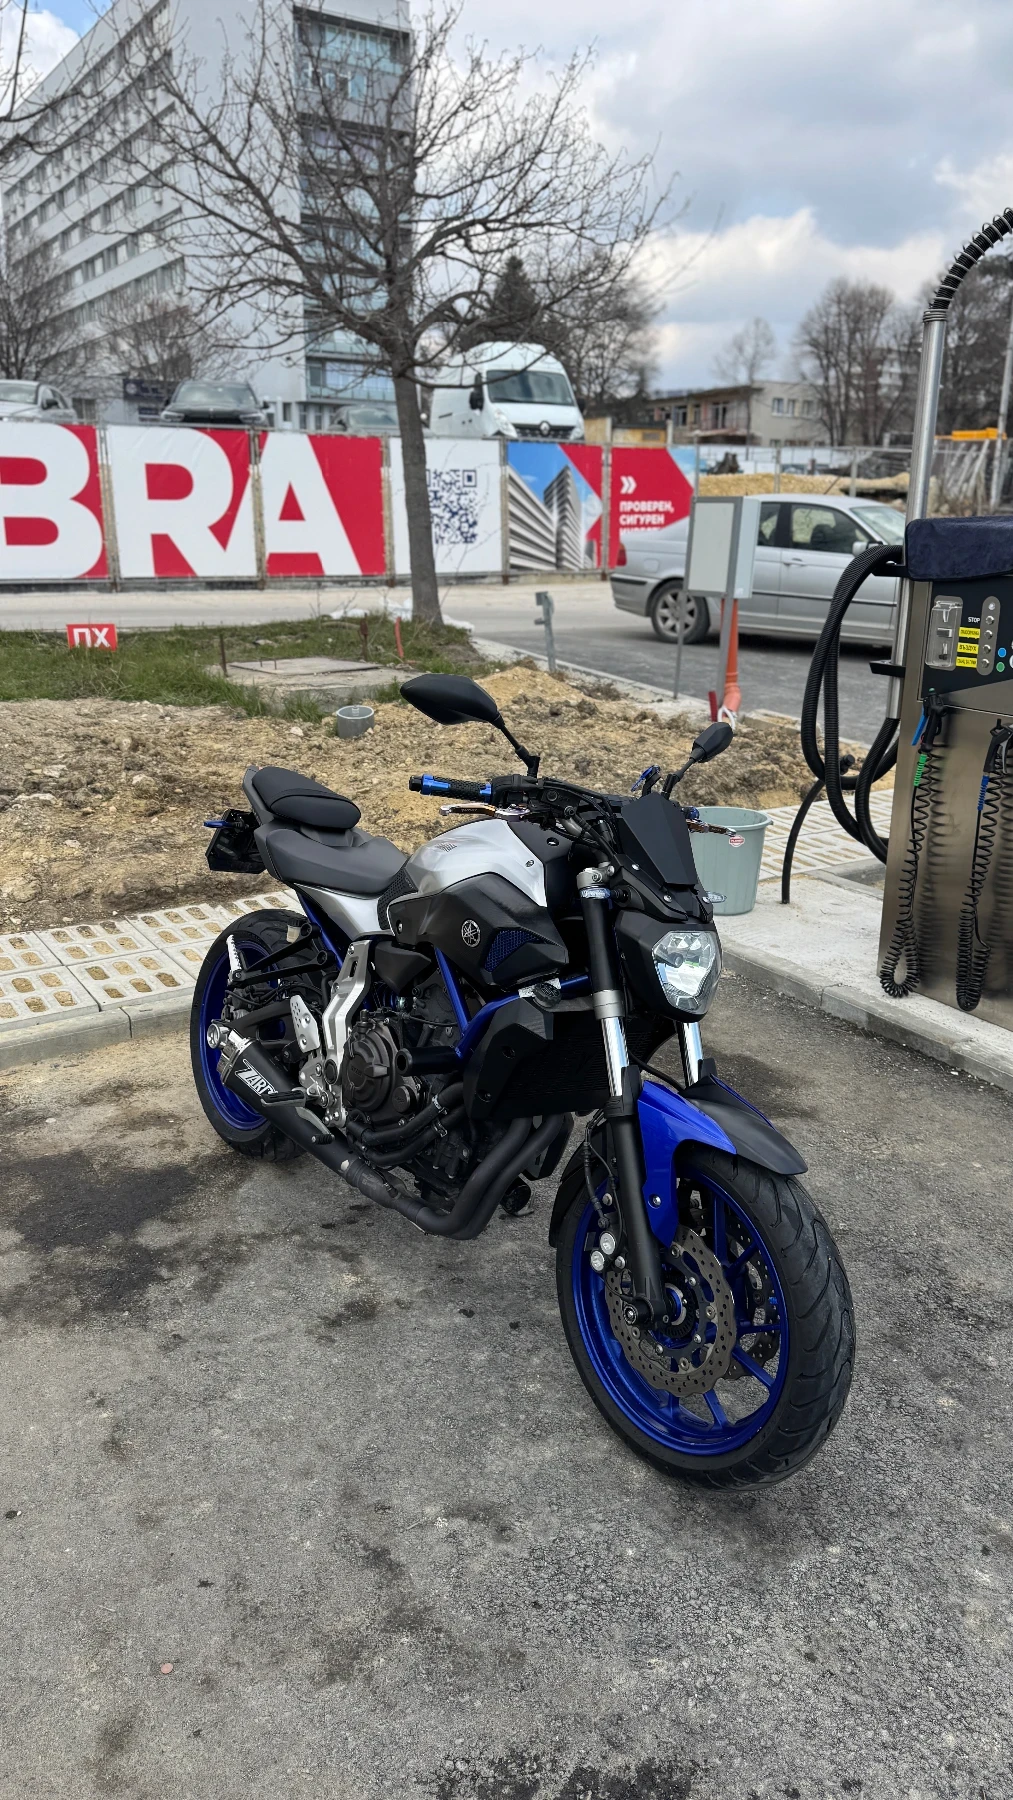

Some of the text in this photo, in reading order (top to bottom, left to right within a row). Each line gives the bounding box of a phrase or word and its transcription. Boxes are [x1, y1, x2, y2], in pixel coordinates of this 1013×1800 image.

[0, 422, 362, 577] BRA
[619, 500, 675, 514] ПРОВЕРЕН,
[619, 513, 665, 525] СИГУРЕН
[72, 627, 112, 648] ПХ
